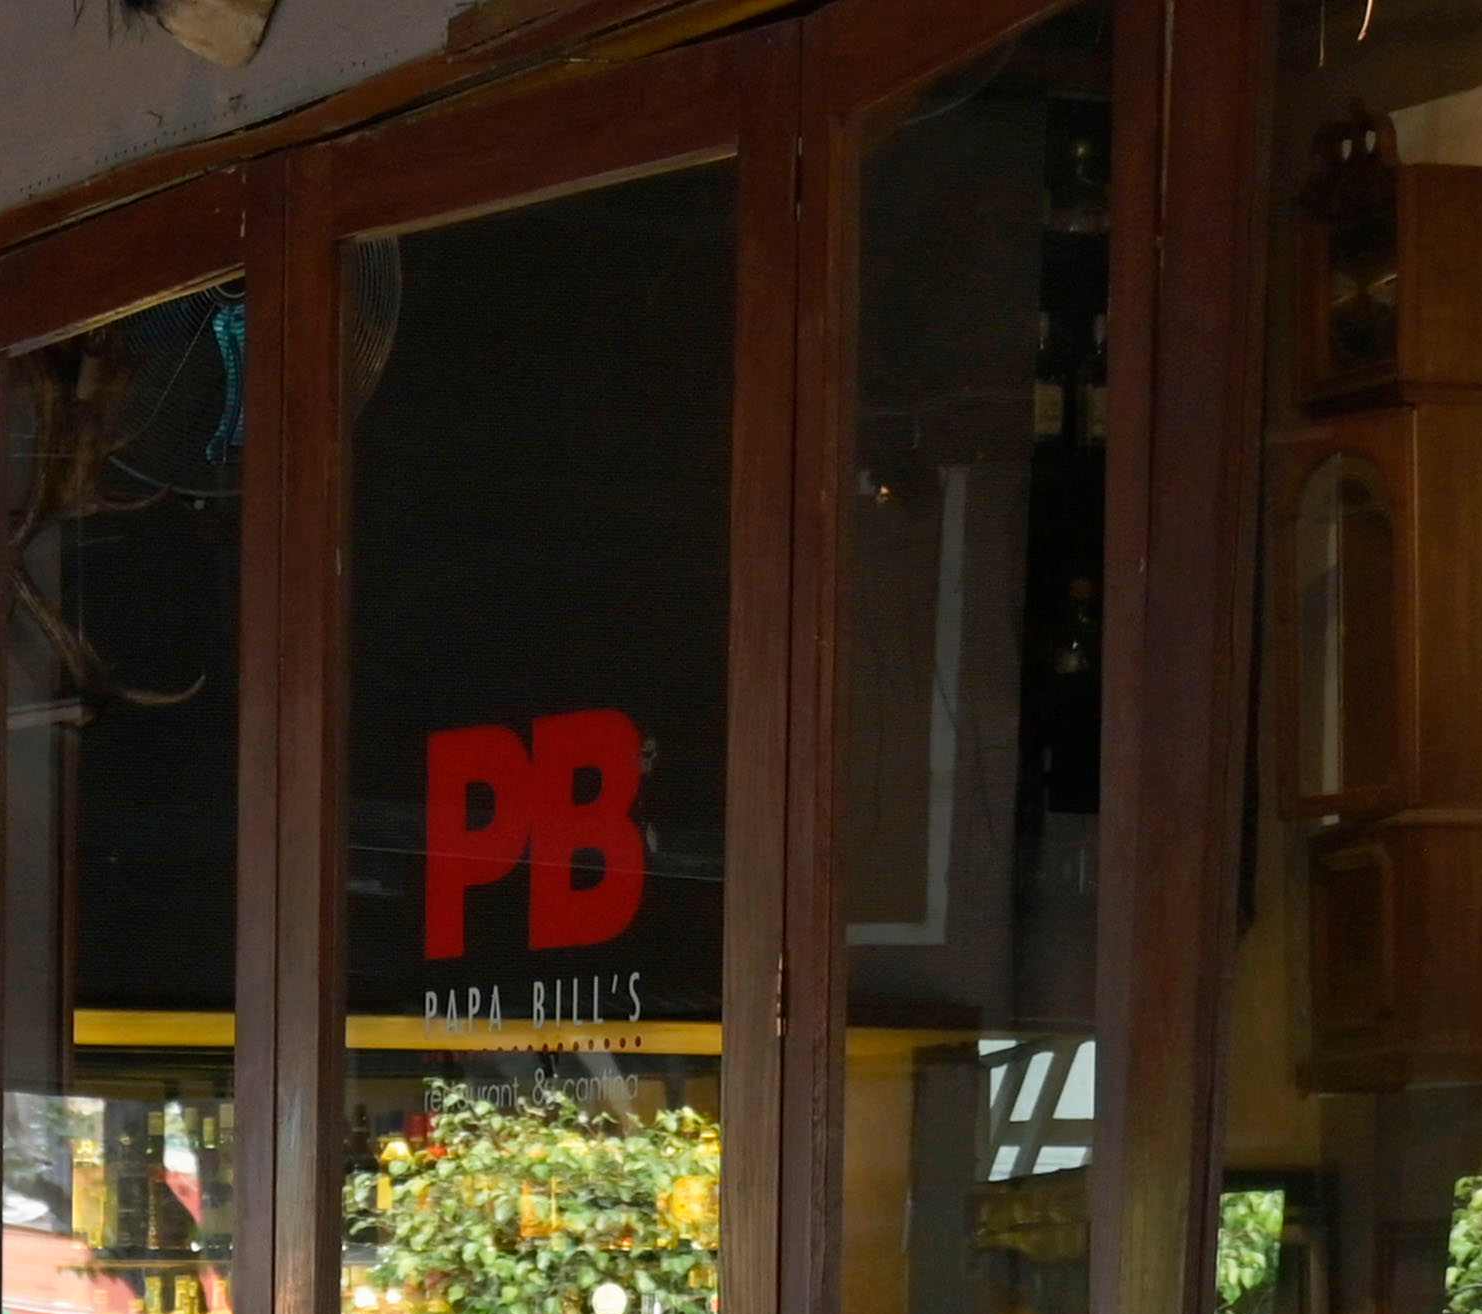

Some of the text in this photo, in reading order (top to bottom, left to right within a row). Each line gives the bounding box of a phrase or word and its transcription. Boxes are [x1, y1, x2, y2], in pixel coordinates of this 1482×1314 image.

[424, 708, 645, 960] PB
[425, 971, 642, 1036] PAPA BILL'S
